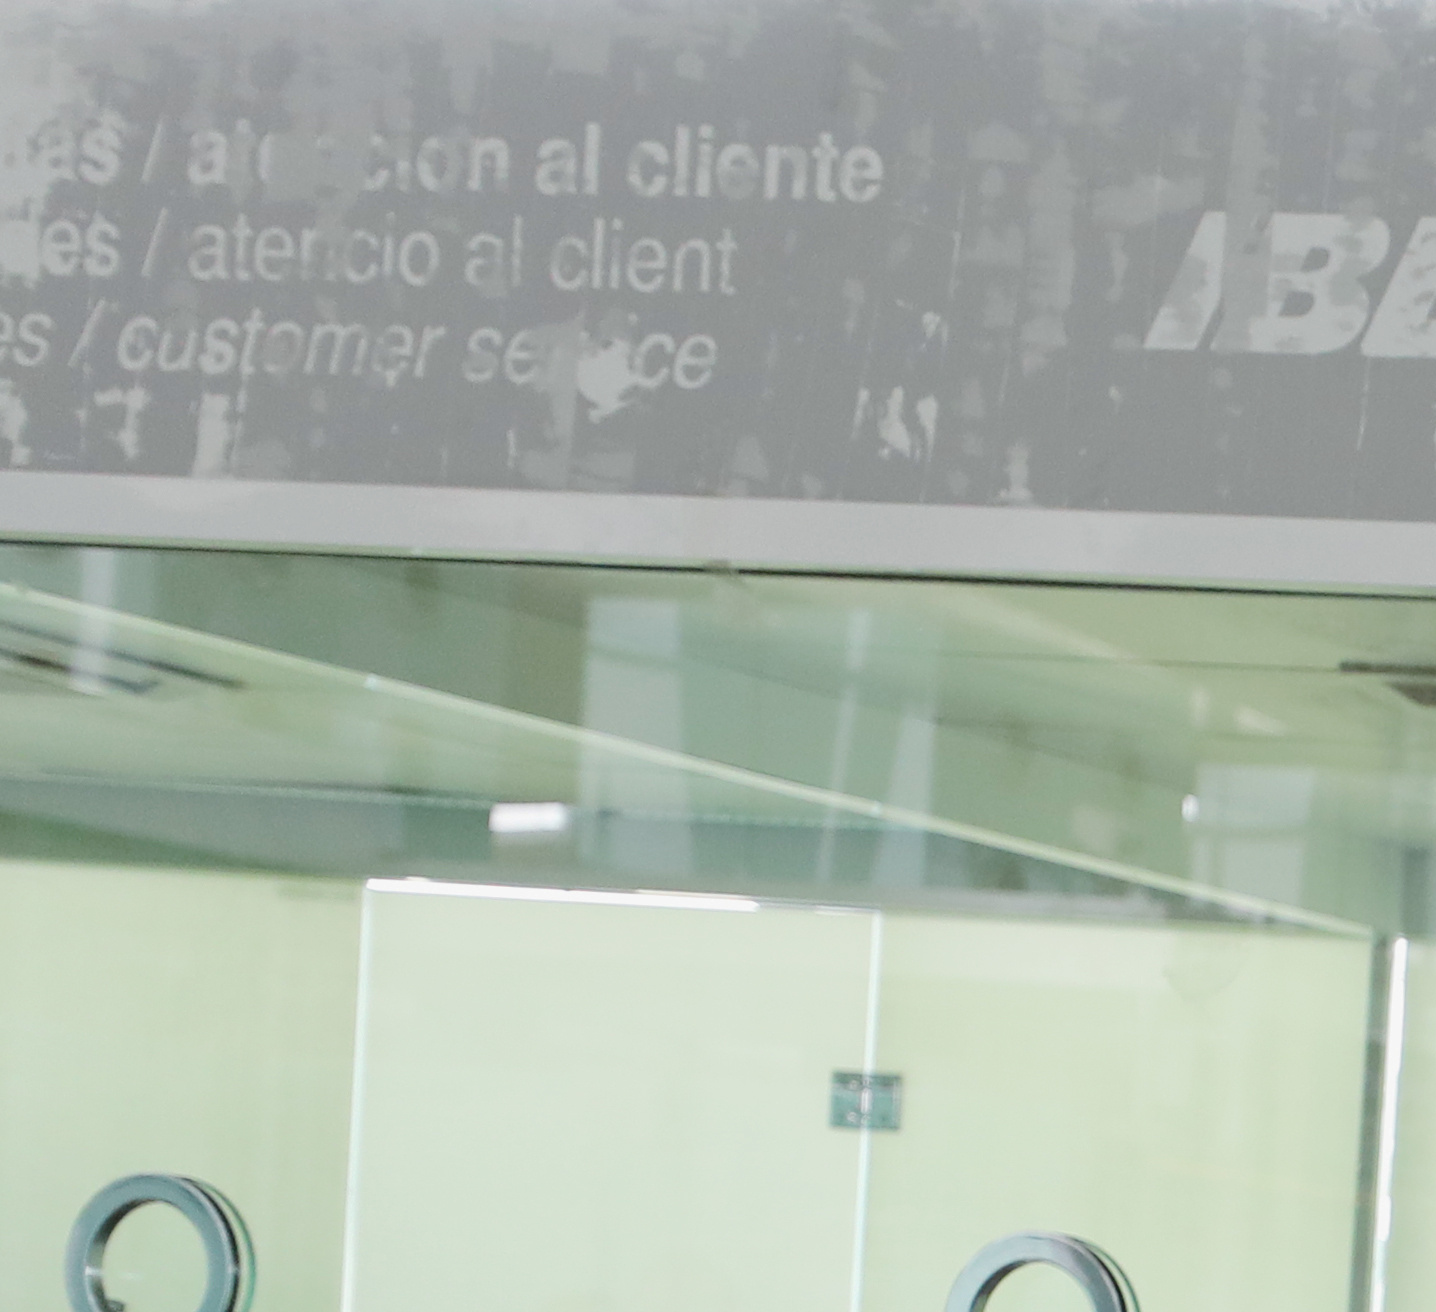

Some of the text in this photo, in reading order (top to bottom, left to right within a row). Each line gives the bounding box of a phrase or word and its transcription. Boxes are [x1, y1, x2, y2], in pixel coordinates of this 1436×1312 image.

[534, 121, 600, 196] al
[627, 122, 885, 203] cliente
[464, 214, 523, 288] al
[550, 217, 737, 295] client
[117, 308, 447, 379] customer
